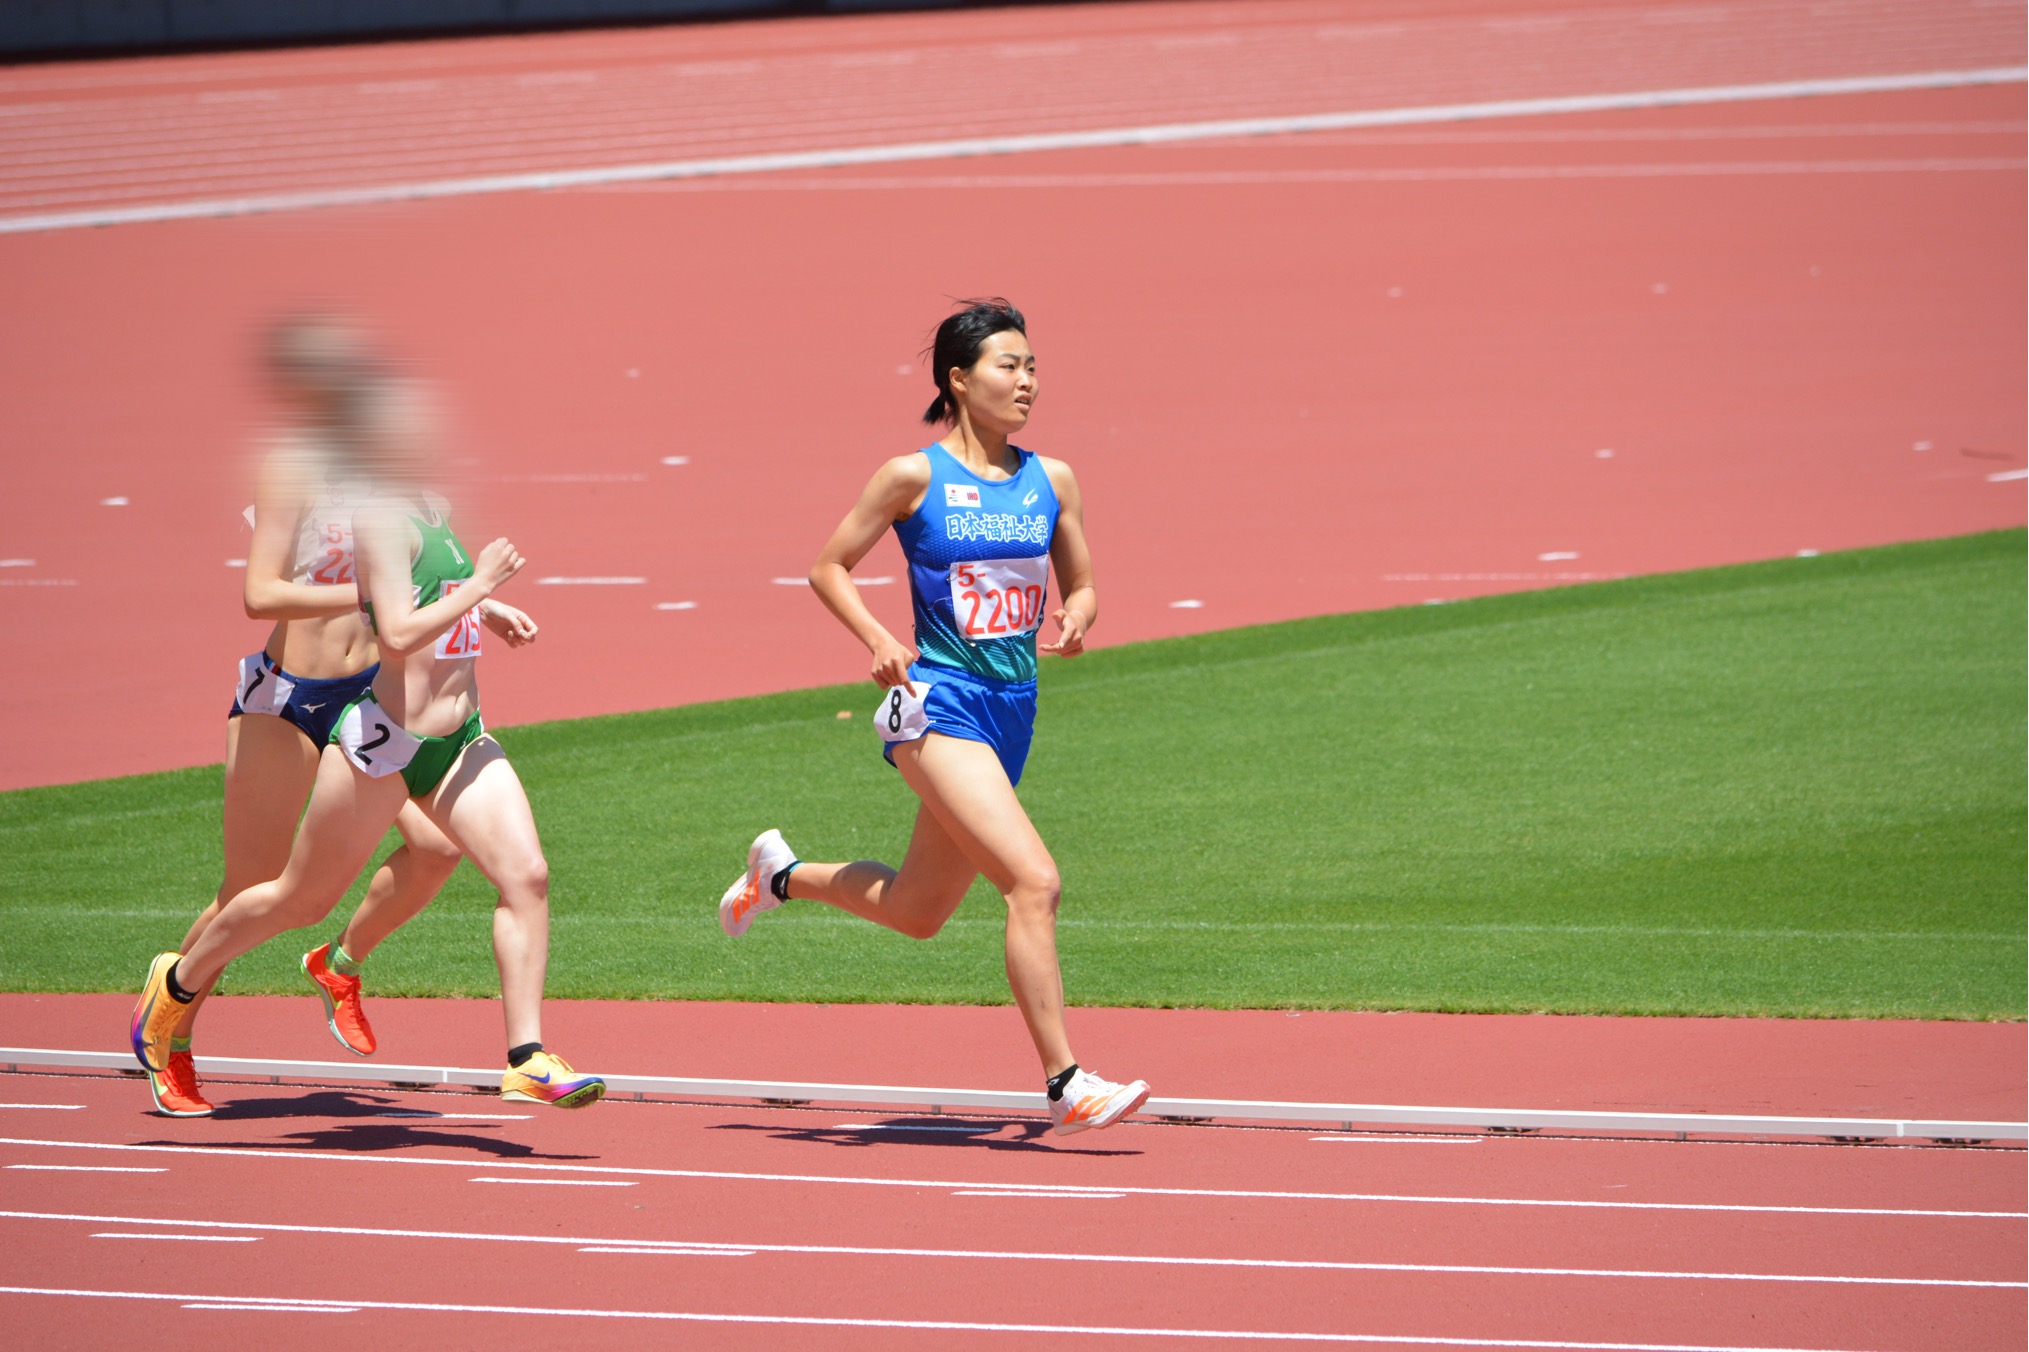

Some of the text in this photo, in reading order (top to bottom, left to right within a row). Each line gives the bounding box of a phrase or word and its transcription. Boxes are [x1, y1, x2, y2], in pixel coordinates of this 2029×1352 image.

[945, 511, 1049, 546] 日本福祉大学
[957, 564, 986, 587] 5-
[961, 584, 1042, 635] 2200
[243, 666, 265, 704] 7
[888, 689, 902, 733] 8
[354, 723, 390, 766] 2
